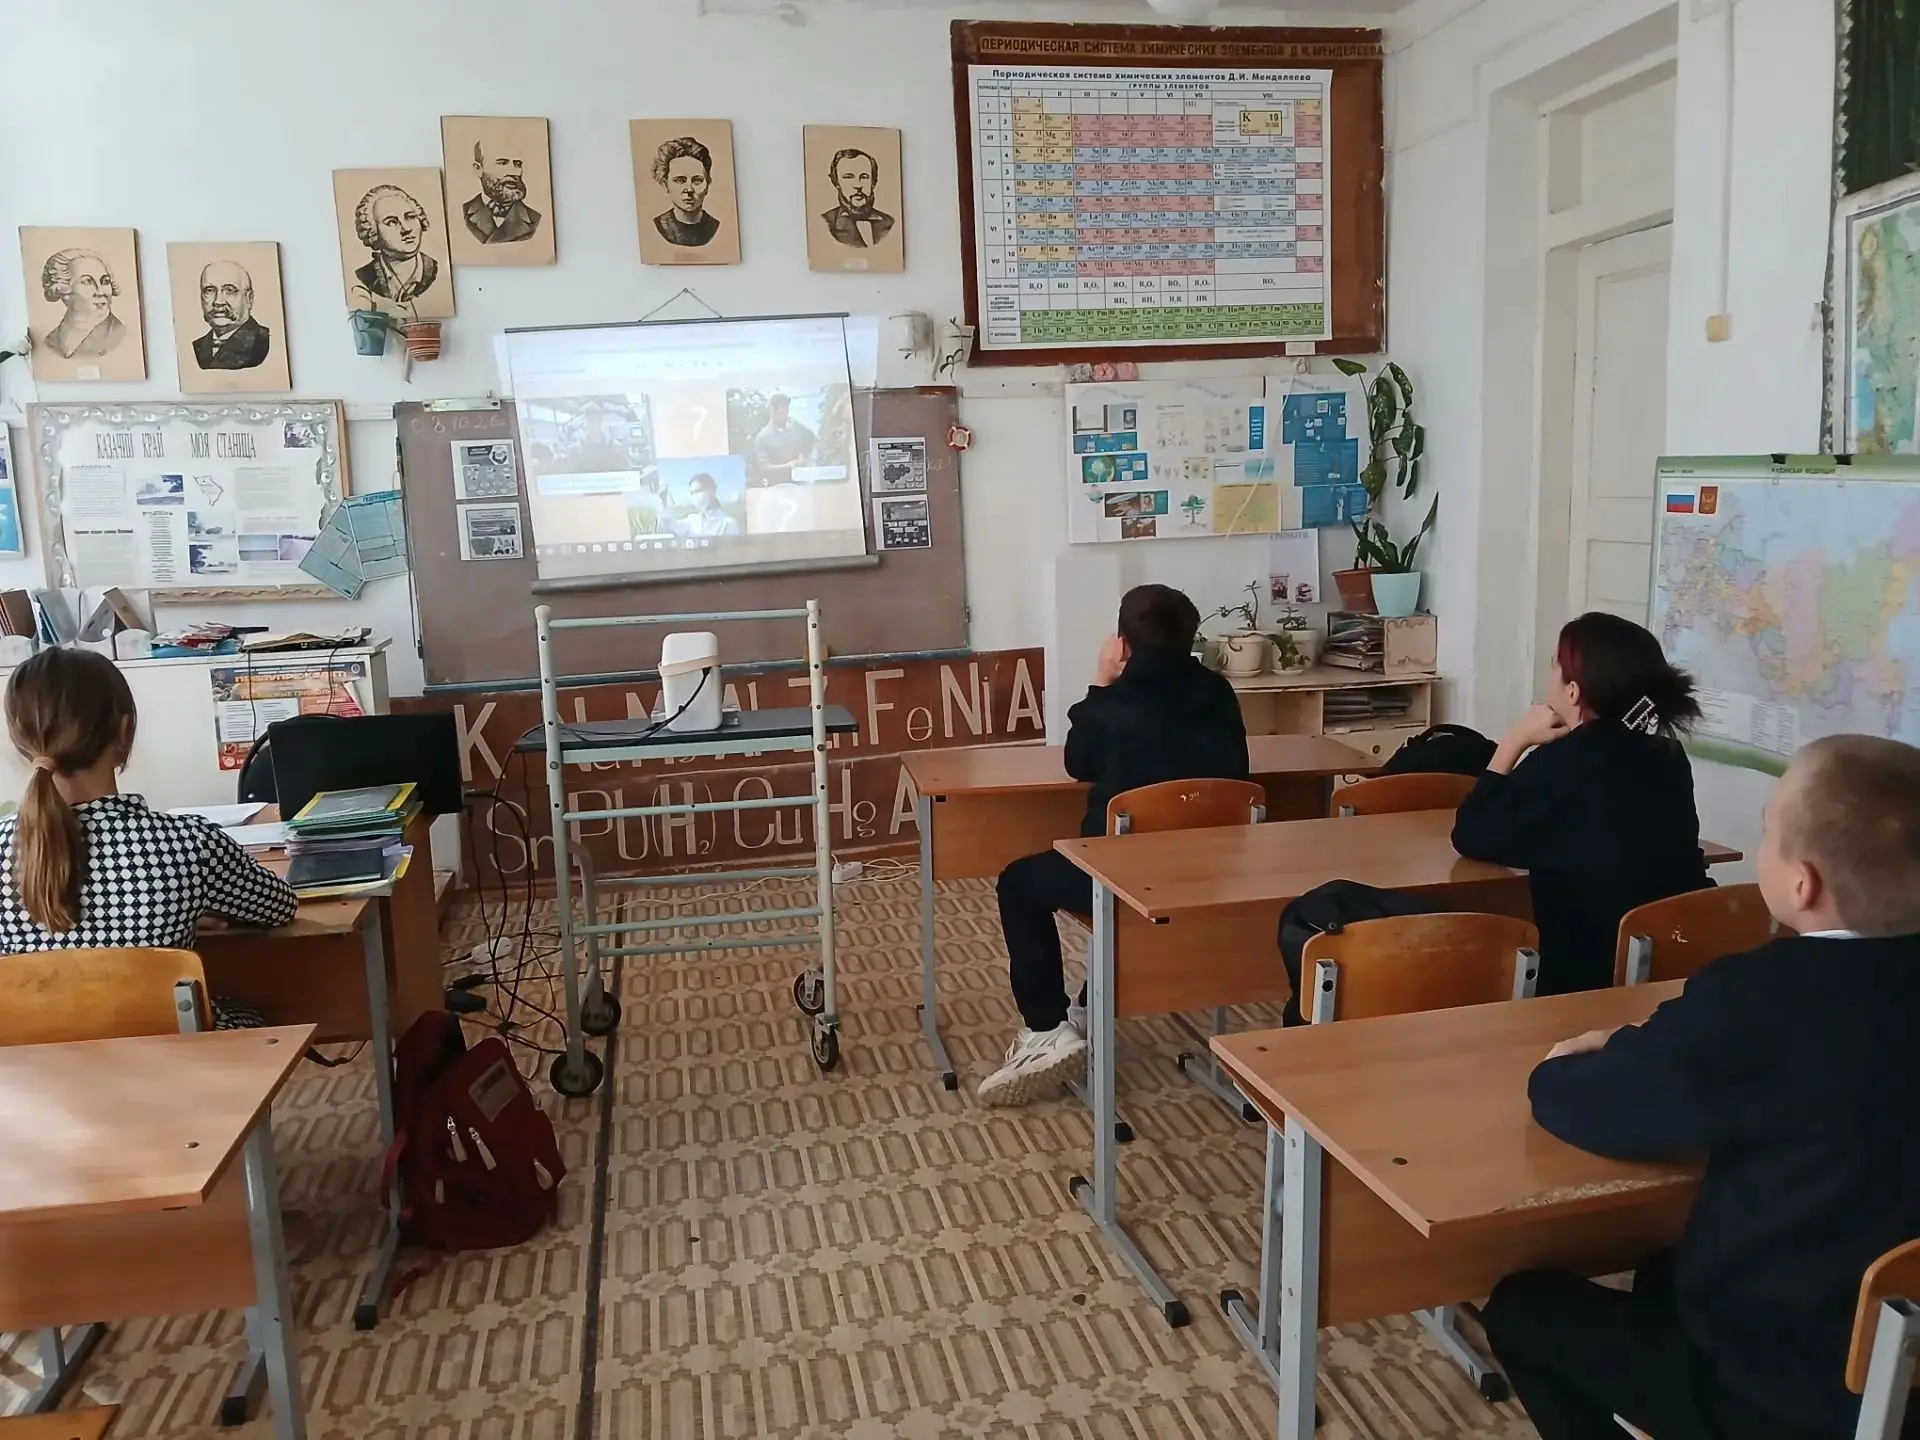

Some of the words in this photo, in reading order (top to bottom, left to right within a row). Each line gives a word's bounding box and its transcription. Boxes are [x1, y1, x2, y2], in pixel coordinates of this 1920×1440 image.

[981, 38, 1079, 53] ПЕРИОДИЧЕСКАЯ
[1084, 42, 1137, 54] СИСТЕМА
[1140, 43, 1216, 56] ХИМИЧЕСКИХ
[1221, 44, 1285, 56] ЭЛЕМЕНТОВ
[992, 69, 1070, 79] Периодическая
[1073, 72, 1112, 80] система
[1175, 73, 1226, 81] элементов
[1251, 73, 1311, 82] Менделеева
[1242, 112, 1251, 122] K
[1269, 113, 1279, 121] 19
[96, 425, 135, 459] КАЗАЧИЙ
[141, 425, 165, 458] КРАЙ
[190, 432, 210, 458] МОЯ
[216, 432, 257, 460] СТАНИЦА
[454, 702, 506, 781] K
[865, 668, 933, 742] Fe
[940, 662, 993, 738] Ni
[1006, 658, 1046, 732] A
[733, 776, 804, 849] Cu
